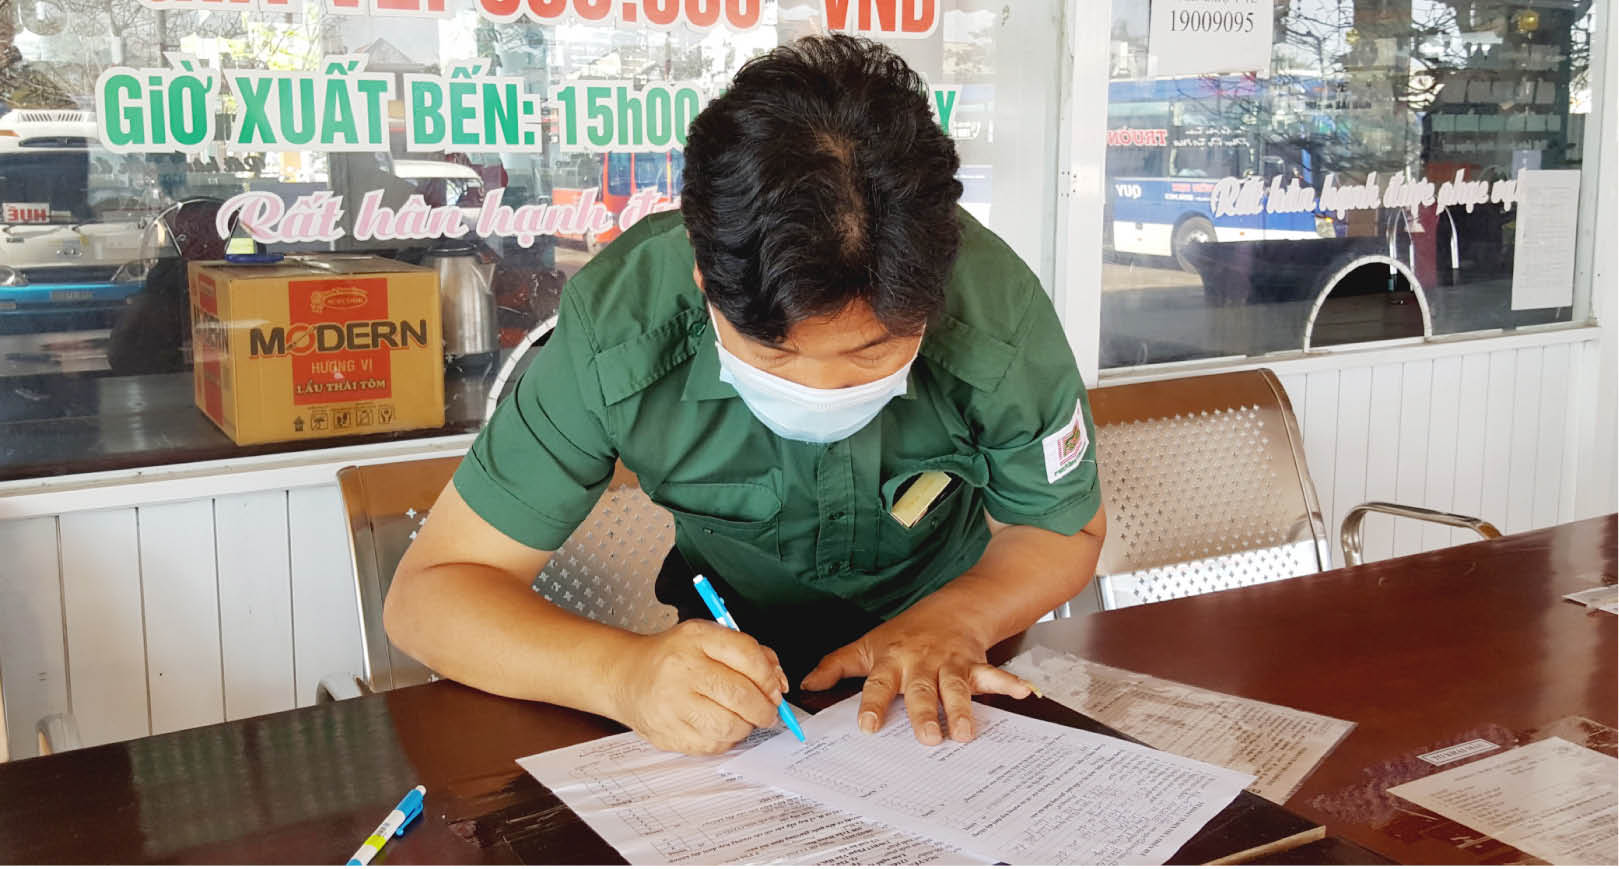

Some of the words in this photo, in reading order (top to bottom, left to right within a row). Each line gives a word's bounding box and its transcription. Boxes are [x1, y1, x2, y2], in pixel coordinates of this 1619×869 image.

[1169, 9, 1254, 33] 19009095
[235, 61, 389, 145] XUẤT
[411, 65, 536, 145] BẾN:
[557, 86, 700, 147] 15h00
[1319, 171, 1380, 220] hạnh
[217, 191, 345, 243] Rất
[354, 189, 468, 240] hân
[476, 187, 614, 248] hạnh
[250, 319, 427, 357] MODERN
[361, 377, 386, 390] TÔM
